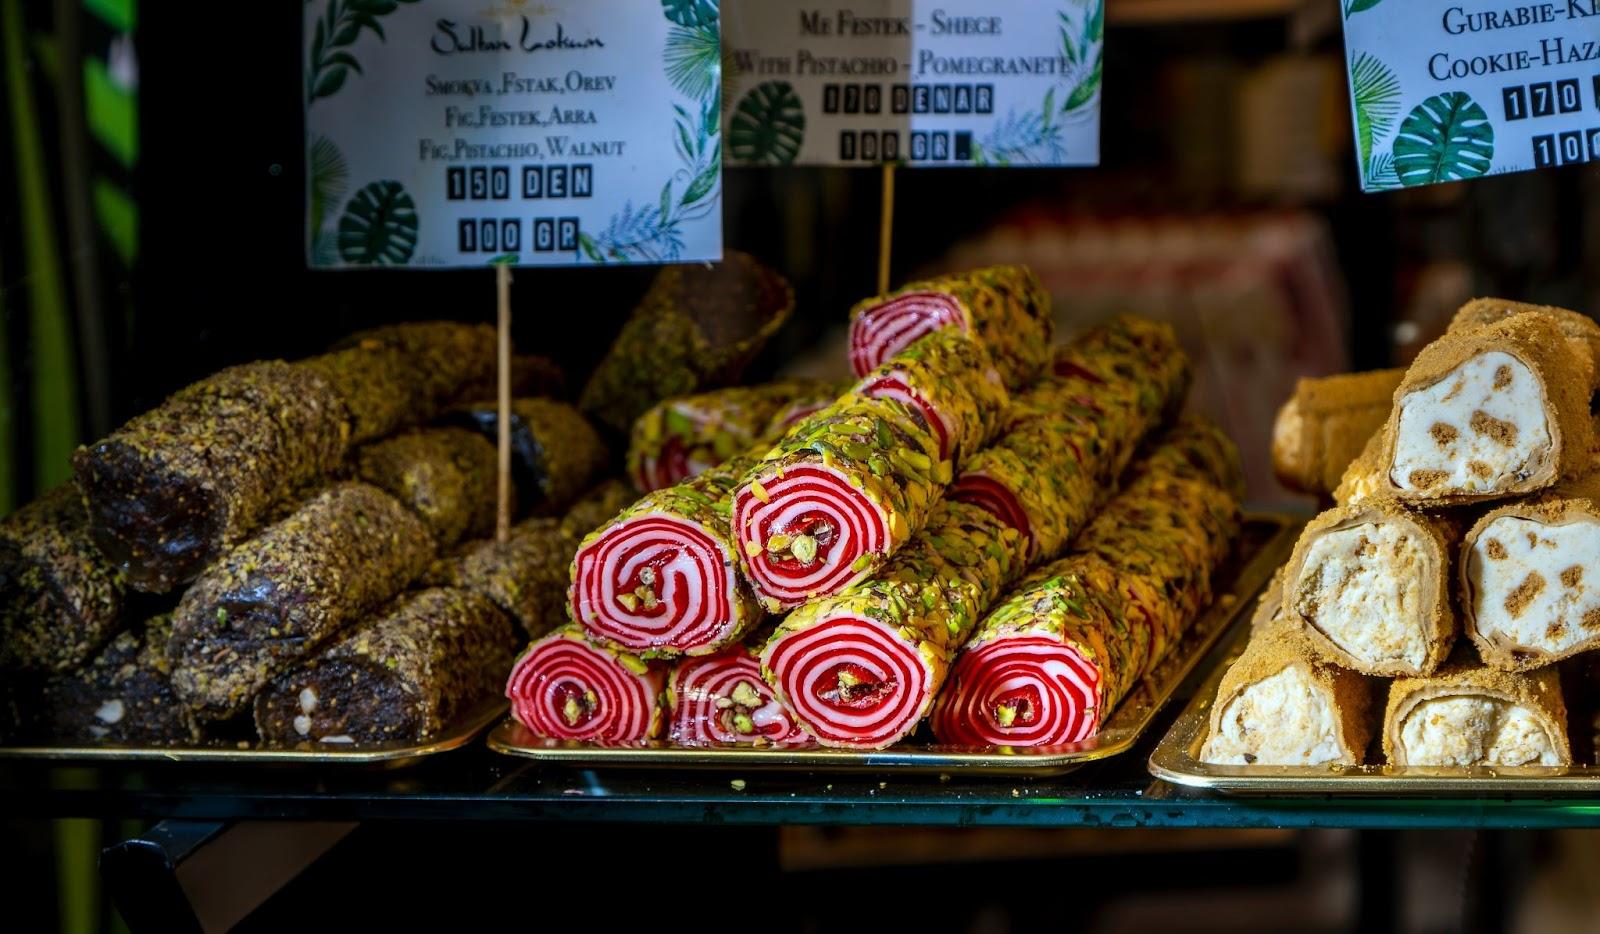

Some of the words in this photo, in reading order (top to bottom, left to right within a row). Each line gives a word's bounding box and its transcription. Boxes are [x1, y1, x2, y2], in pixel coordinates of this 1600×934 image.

[800, 9, 832, 35] ME
[837, 9, 910, 36] FESTEK
[931, 11, 1002, 35] SHEGE
[734, 50, 791, 74] WITH
[797, 49, 898, 76] PISTACHIO
[1428, 37, 1600, 81] COOKIE-HAZ
[895, 86, 990, 112] DENAR
[1506, 81, 1579, 118] 170
[450, 168, 508, 198] 150
[524, 166, 591, 196] DEN
[461, 220, 519, 250] 100
[536, 219, 578, 249] GR
